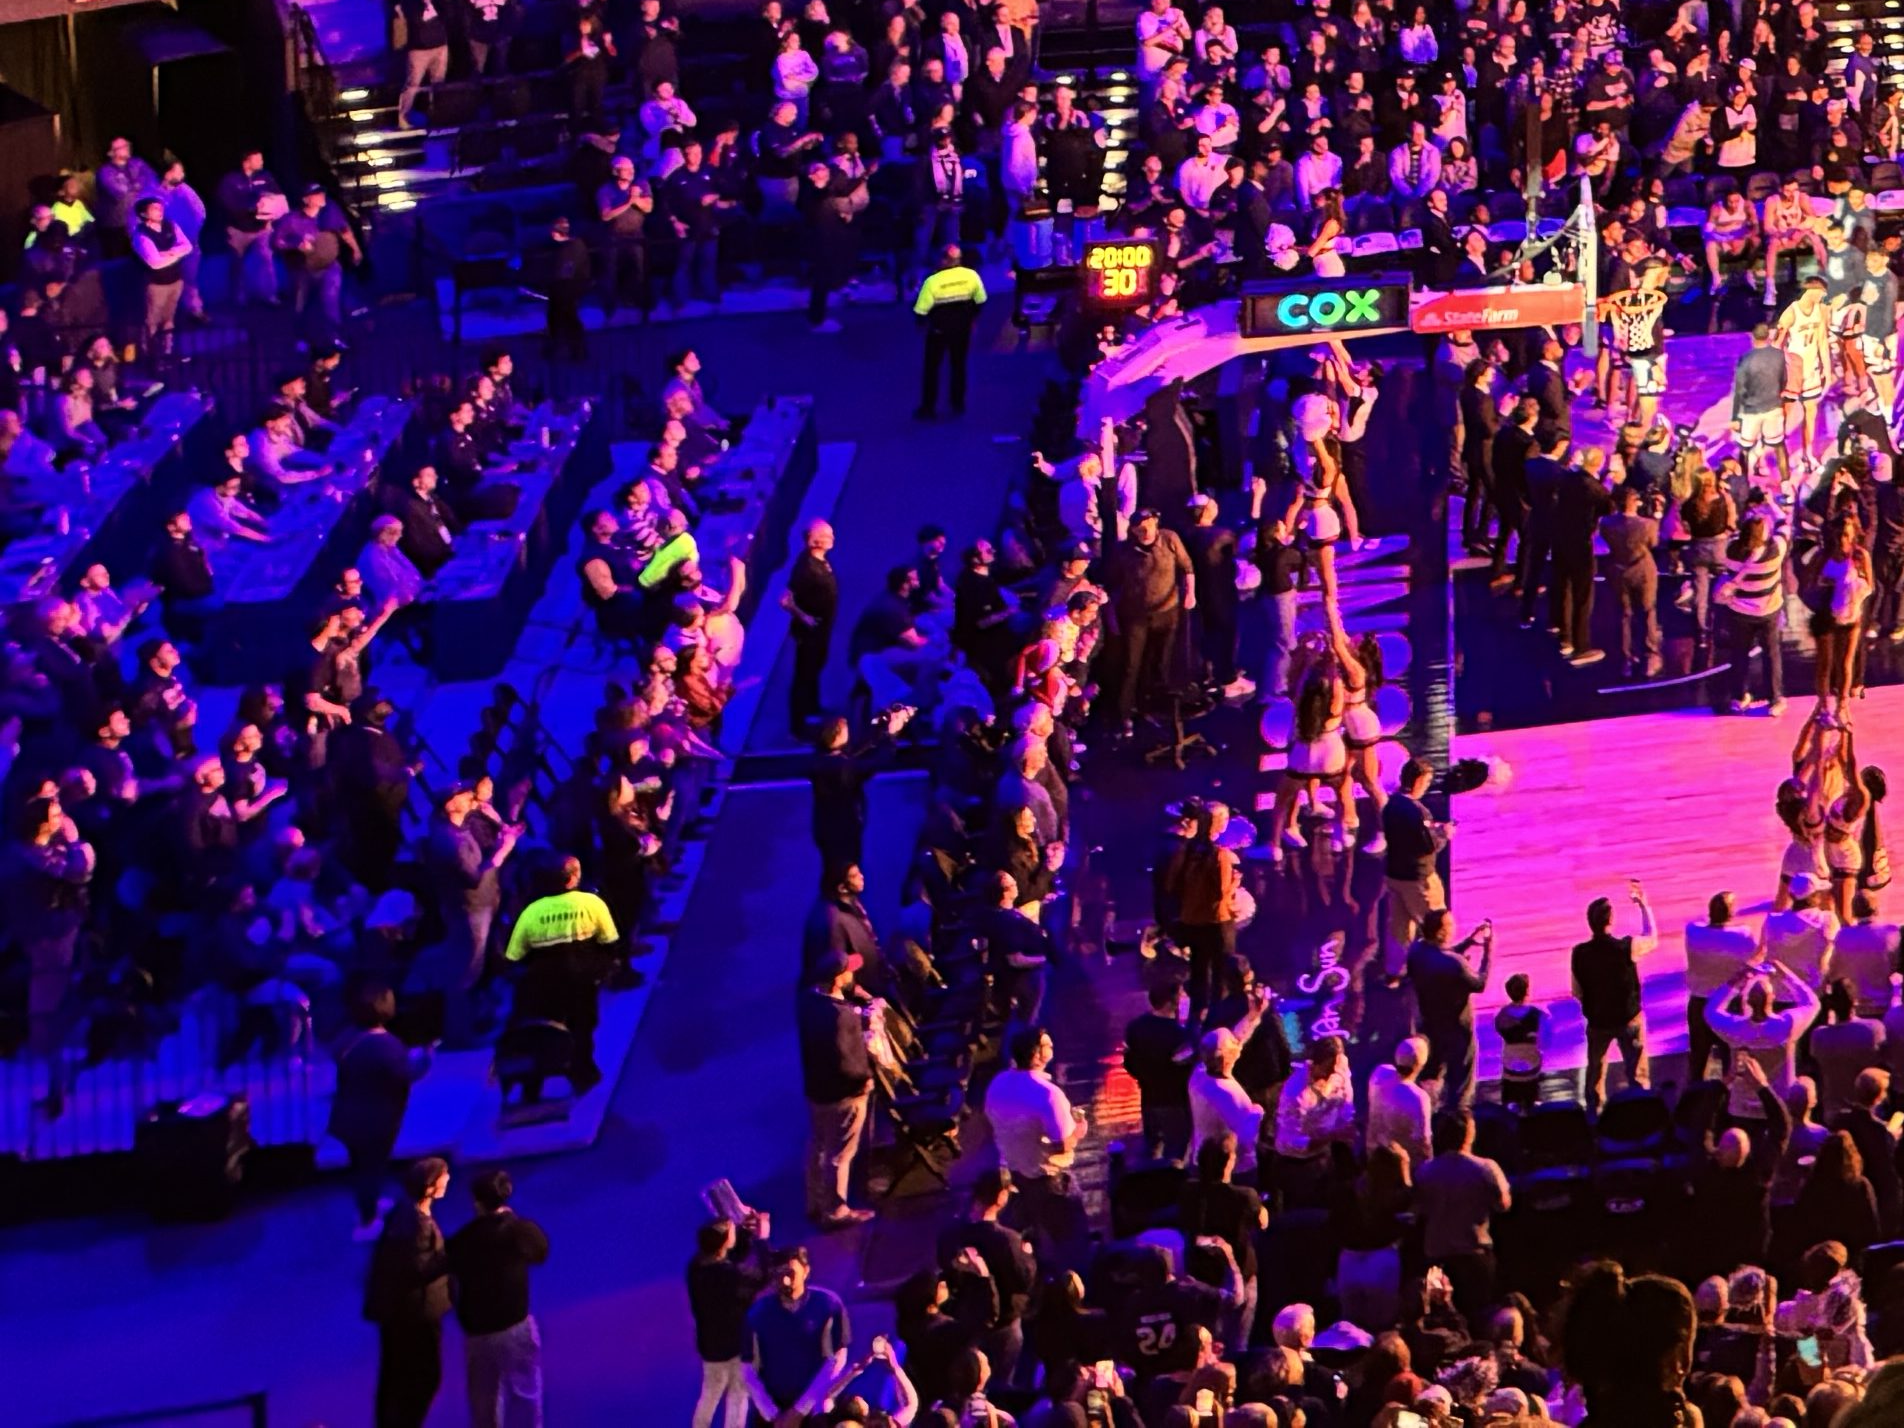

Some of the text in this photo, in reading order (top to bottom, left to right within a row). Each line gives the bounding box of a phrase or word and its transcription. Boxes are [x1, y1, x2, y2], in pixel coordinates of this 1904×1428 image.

[1088, 246, 1153, 269] 20:00
[1103, 268, 1138, 297] 30
[1277, 288, 1381, 327] COX
[1297, 939, 1350, 993] Sun
